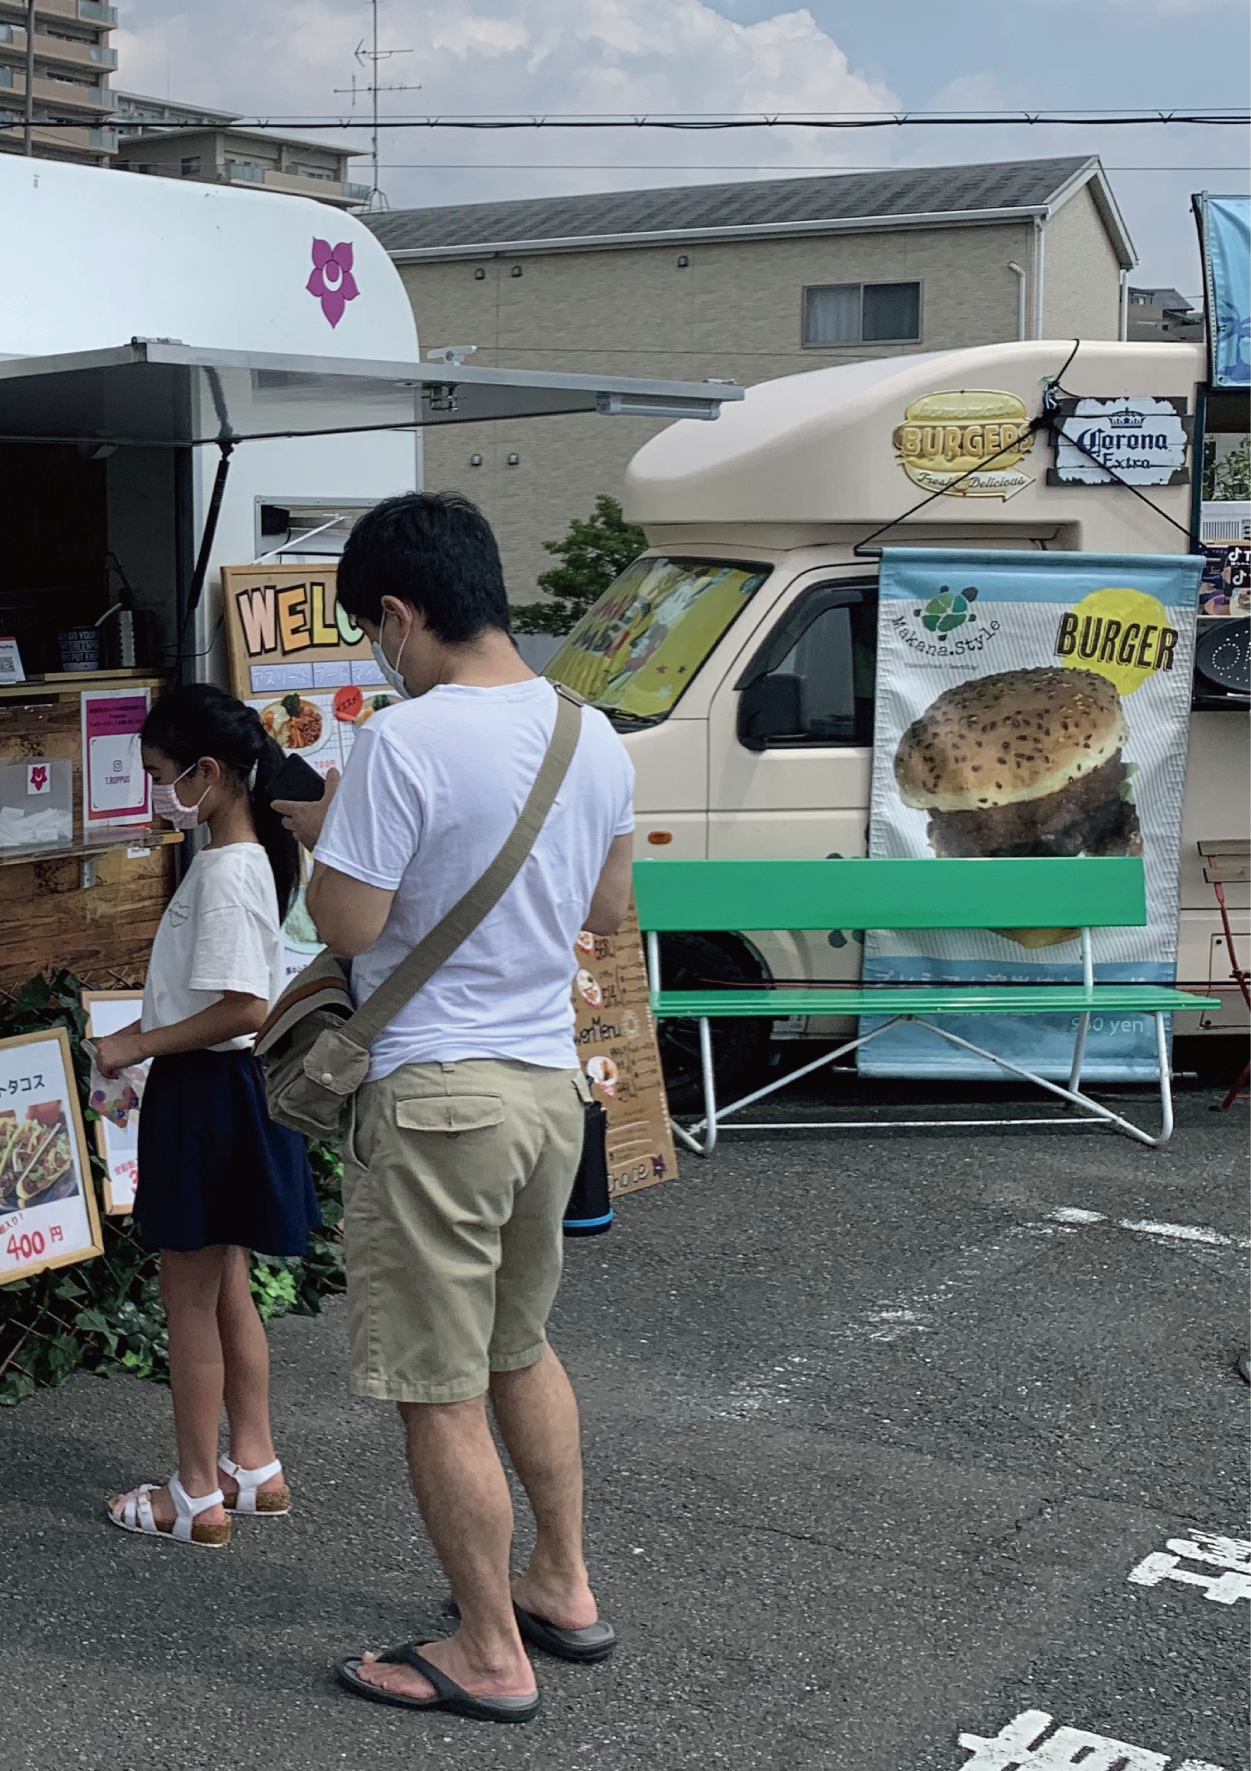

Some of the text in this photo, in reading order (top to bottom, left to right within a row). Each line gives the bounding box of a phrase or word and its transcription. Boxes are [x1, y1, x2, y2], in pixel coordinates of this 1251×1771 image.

[902, 424, 1034, 459] BURGERS
[1076, 427, 1168, 458] Corona
[1102, 452, 1151, 470] Extra
[892, 616, 1001, 656] Makana.Style
[1054, 612, 1178, 671] BURGER
[1109, 1016, 1144, 1034] yen
[7, 1225, 65, 1261] 400 円
